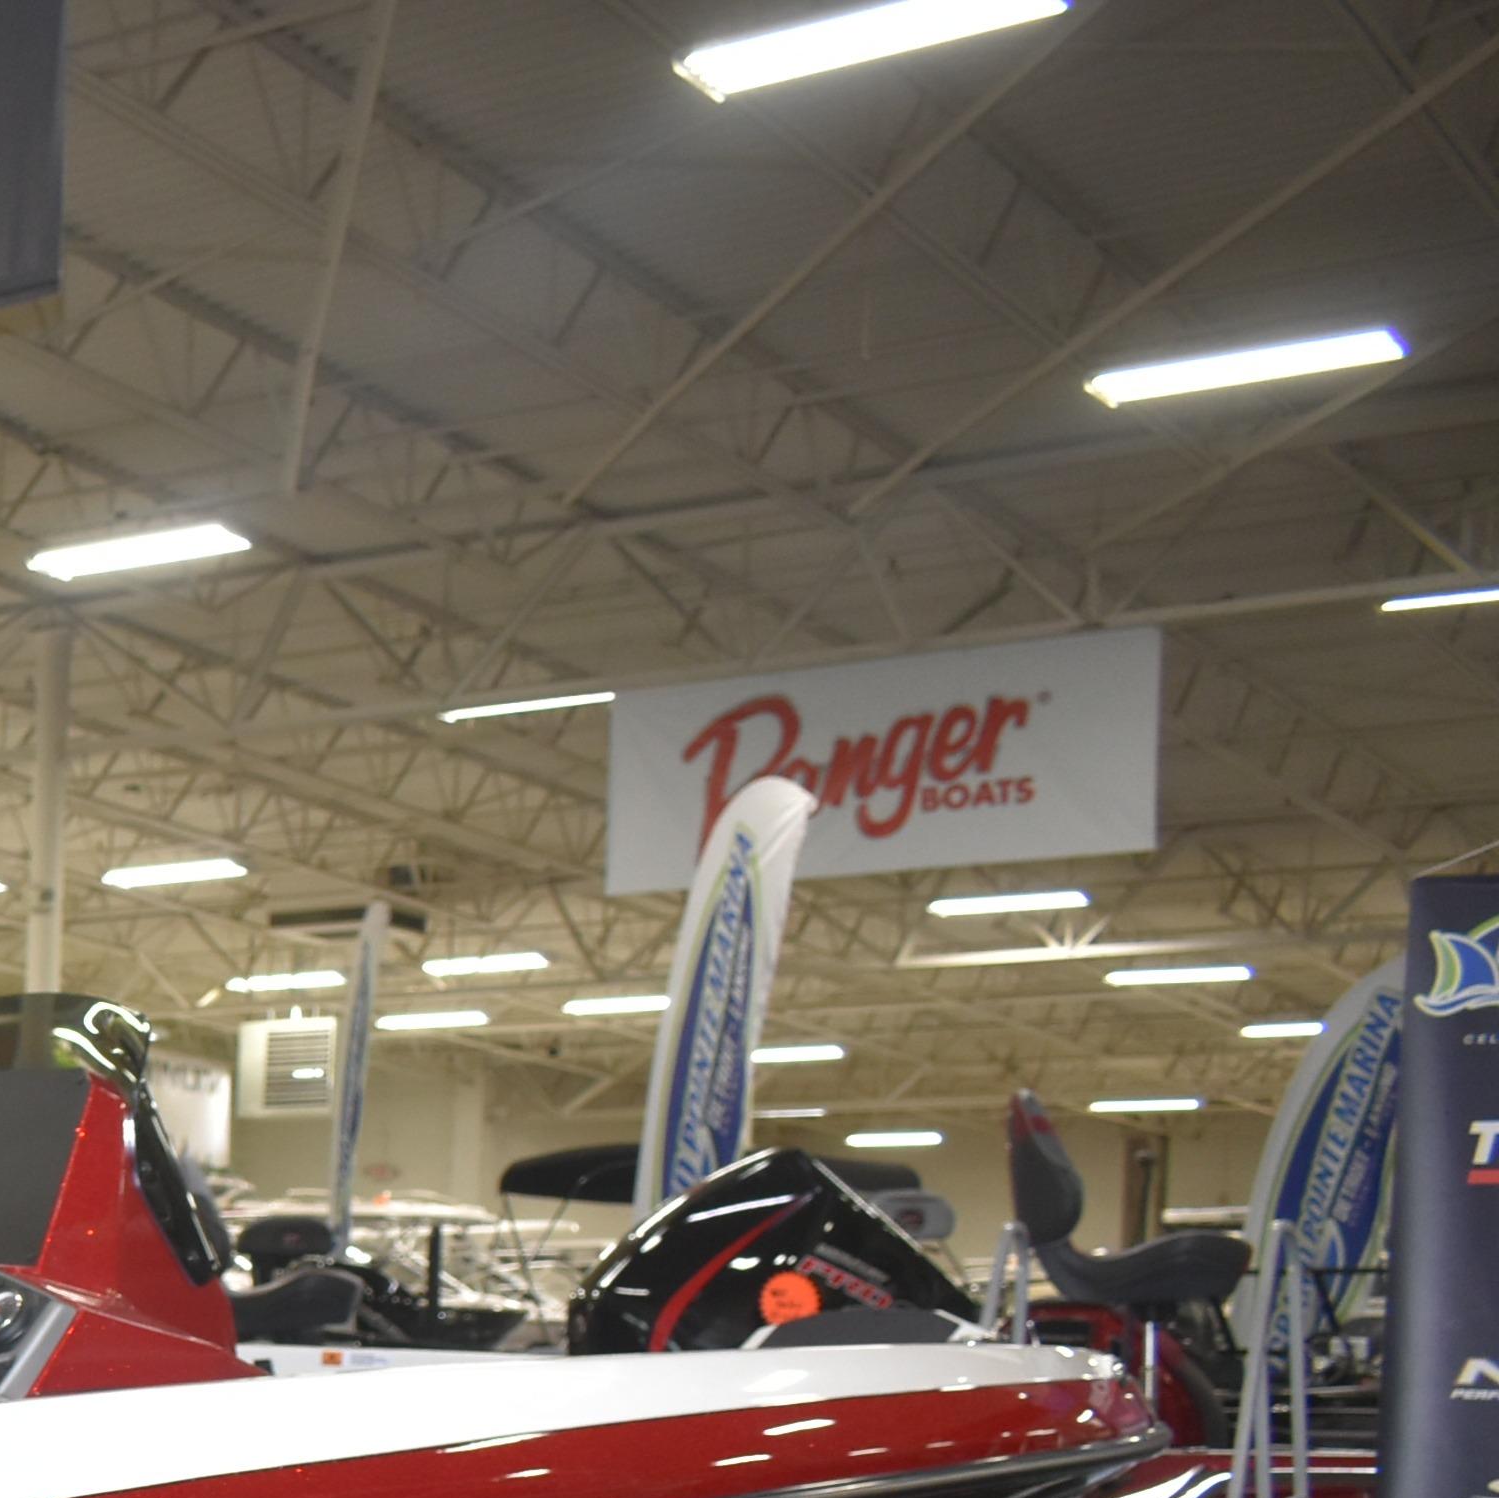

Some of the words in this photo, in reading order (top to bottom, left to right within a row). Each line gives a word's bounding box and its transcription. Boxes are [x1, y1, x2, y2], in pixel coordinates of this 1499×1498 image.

[682, 694, 1029, 866] Ranger
[920, 776, 1036, 813] BOATS
[1333, 991, 1402, 1126] MARINA
